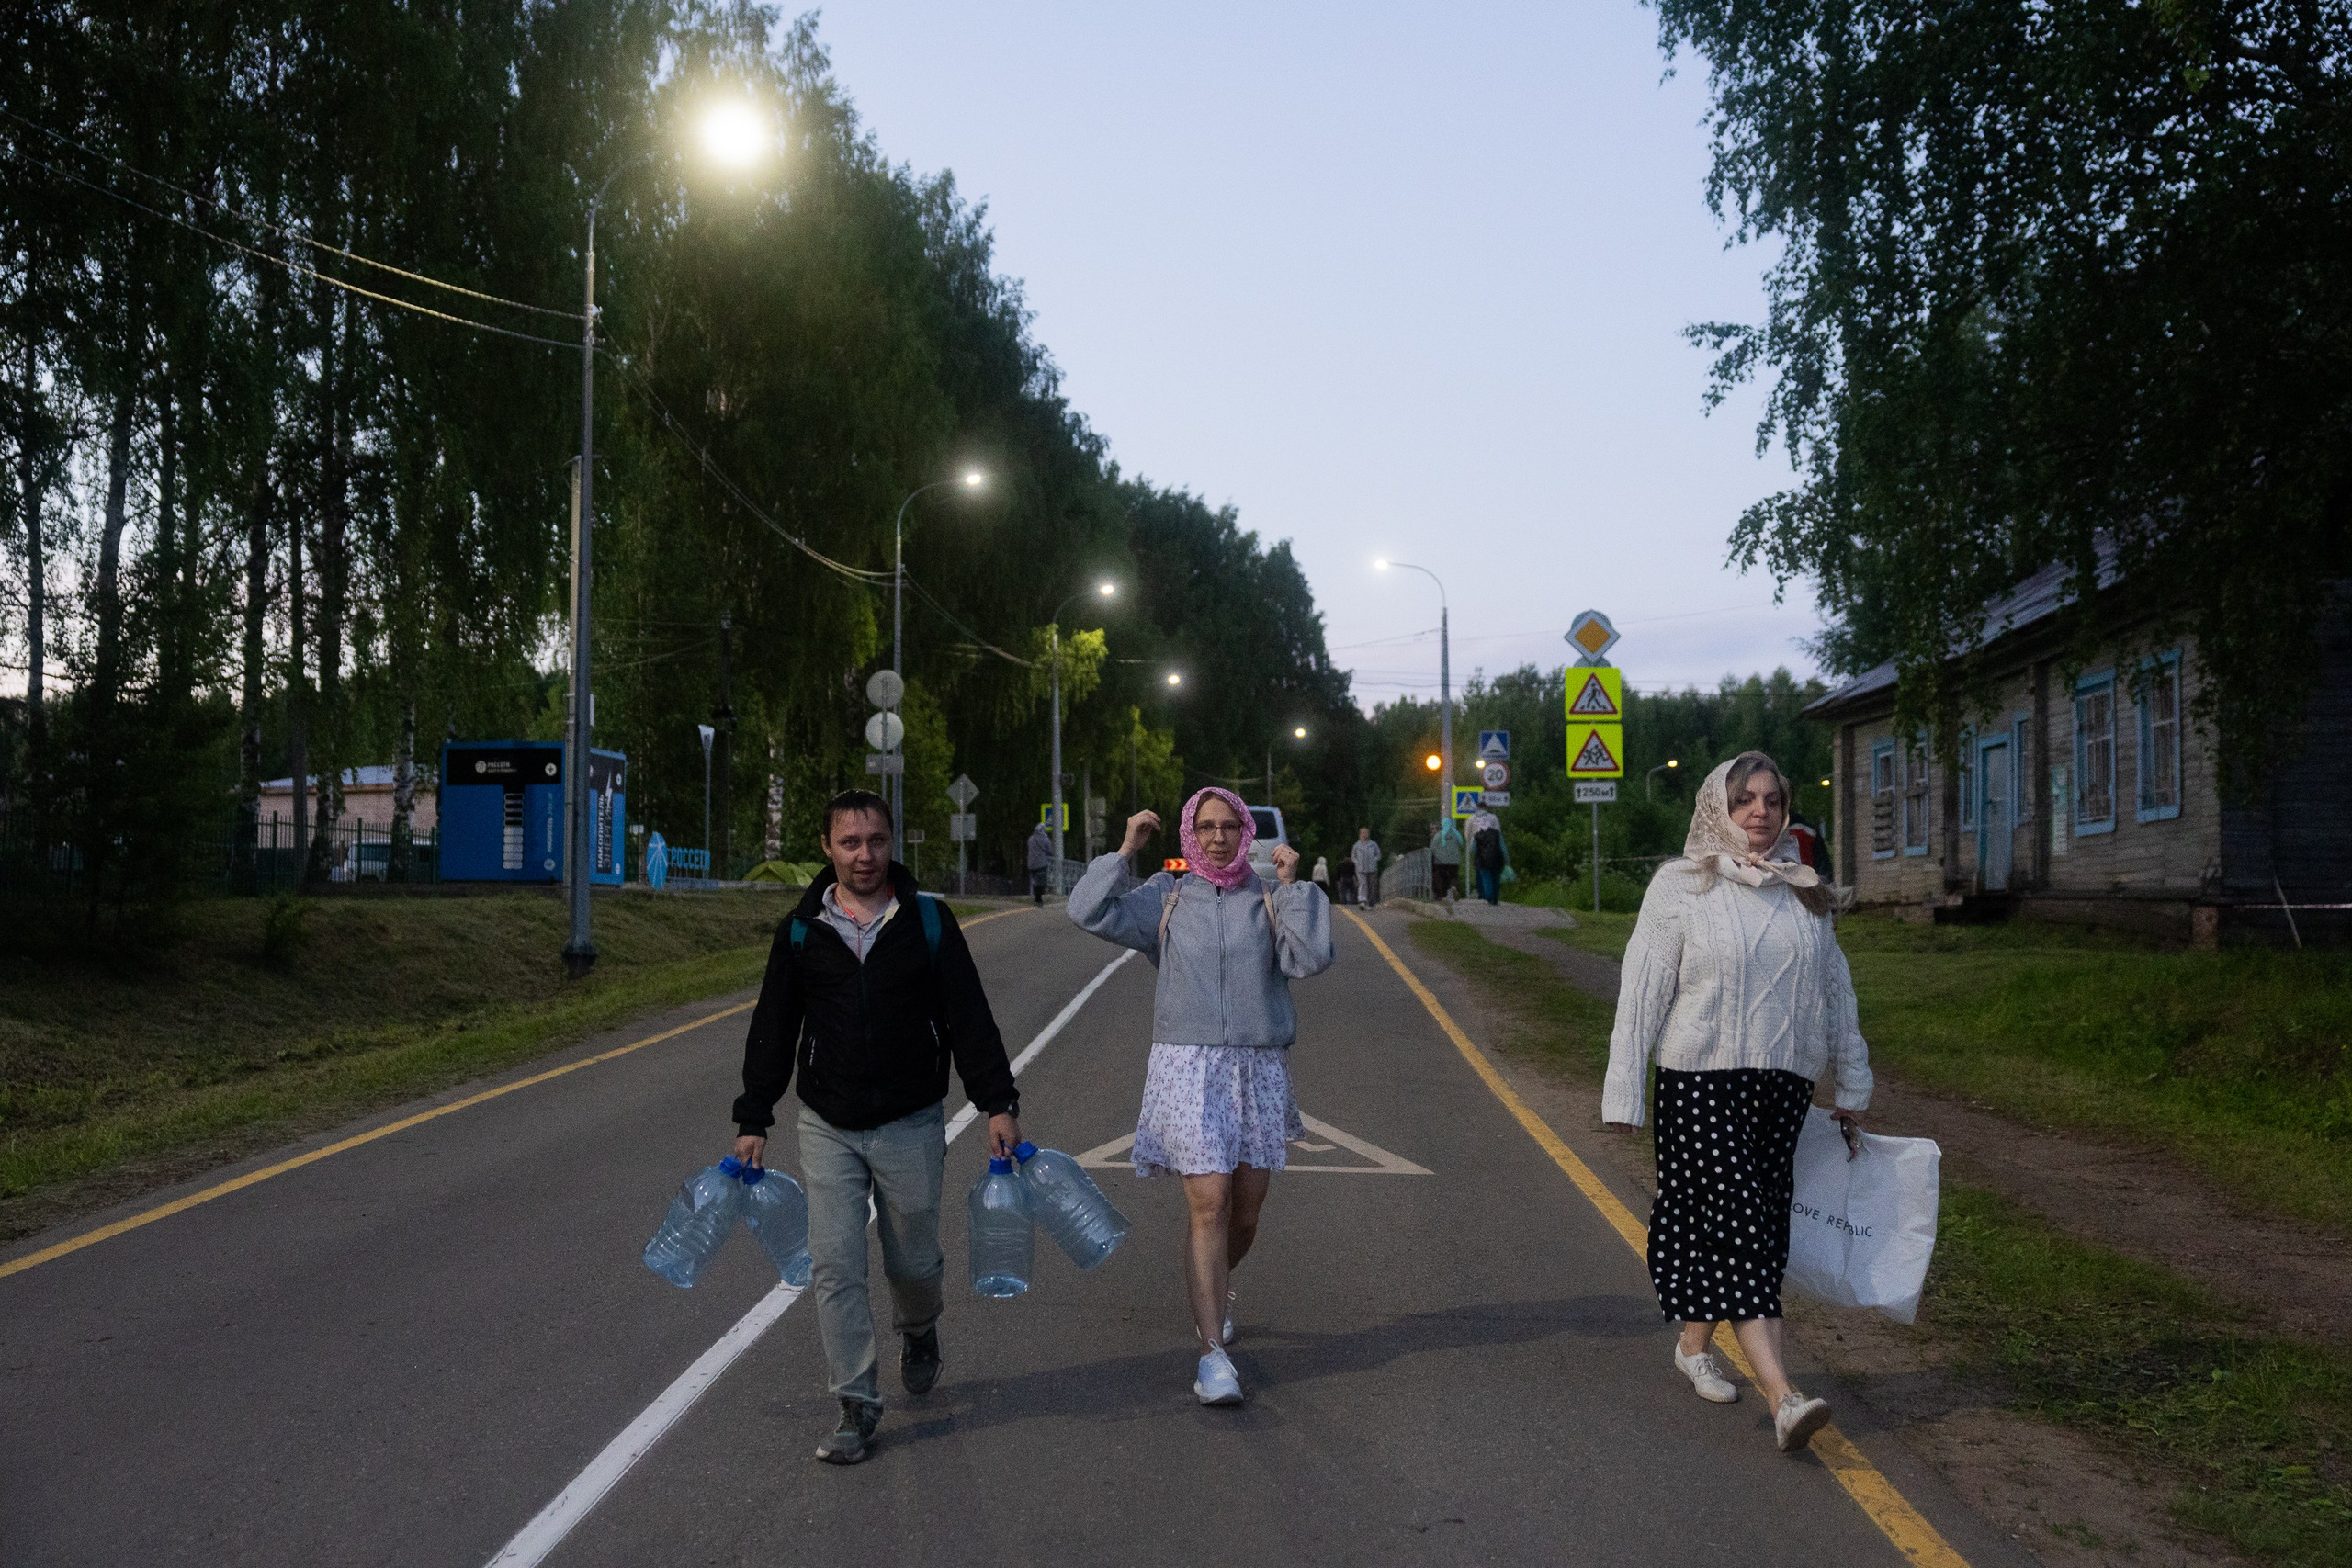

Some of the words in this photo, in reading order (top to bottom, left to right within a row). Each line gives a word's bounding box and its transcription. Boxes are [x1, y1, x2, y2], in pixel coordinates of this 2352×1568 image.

[1487, 770, 1504, 781] 20
[671, 846, 710, 871] РОССЕТИ
[1791, 1202, 1820, 1221] OVE
[1826, 1214, 1873, 1237] REPBLIC
